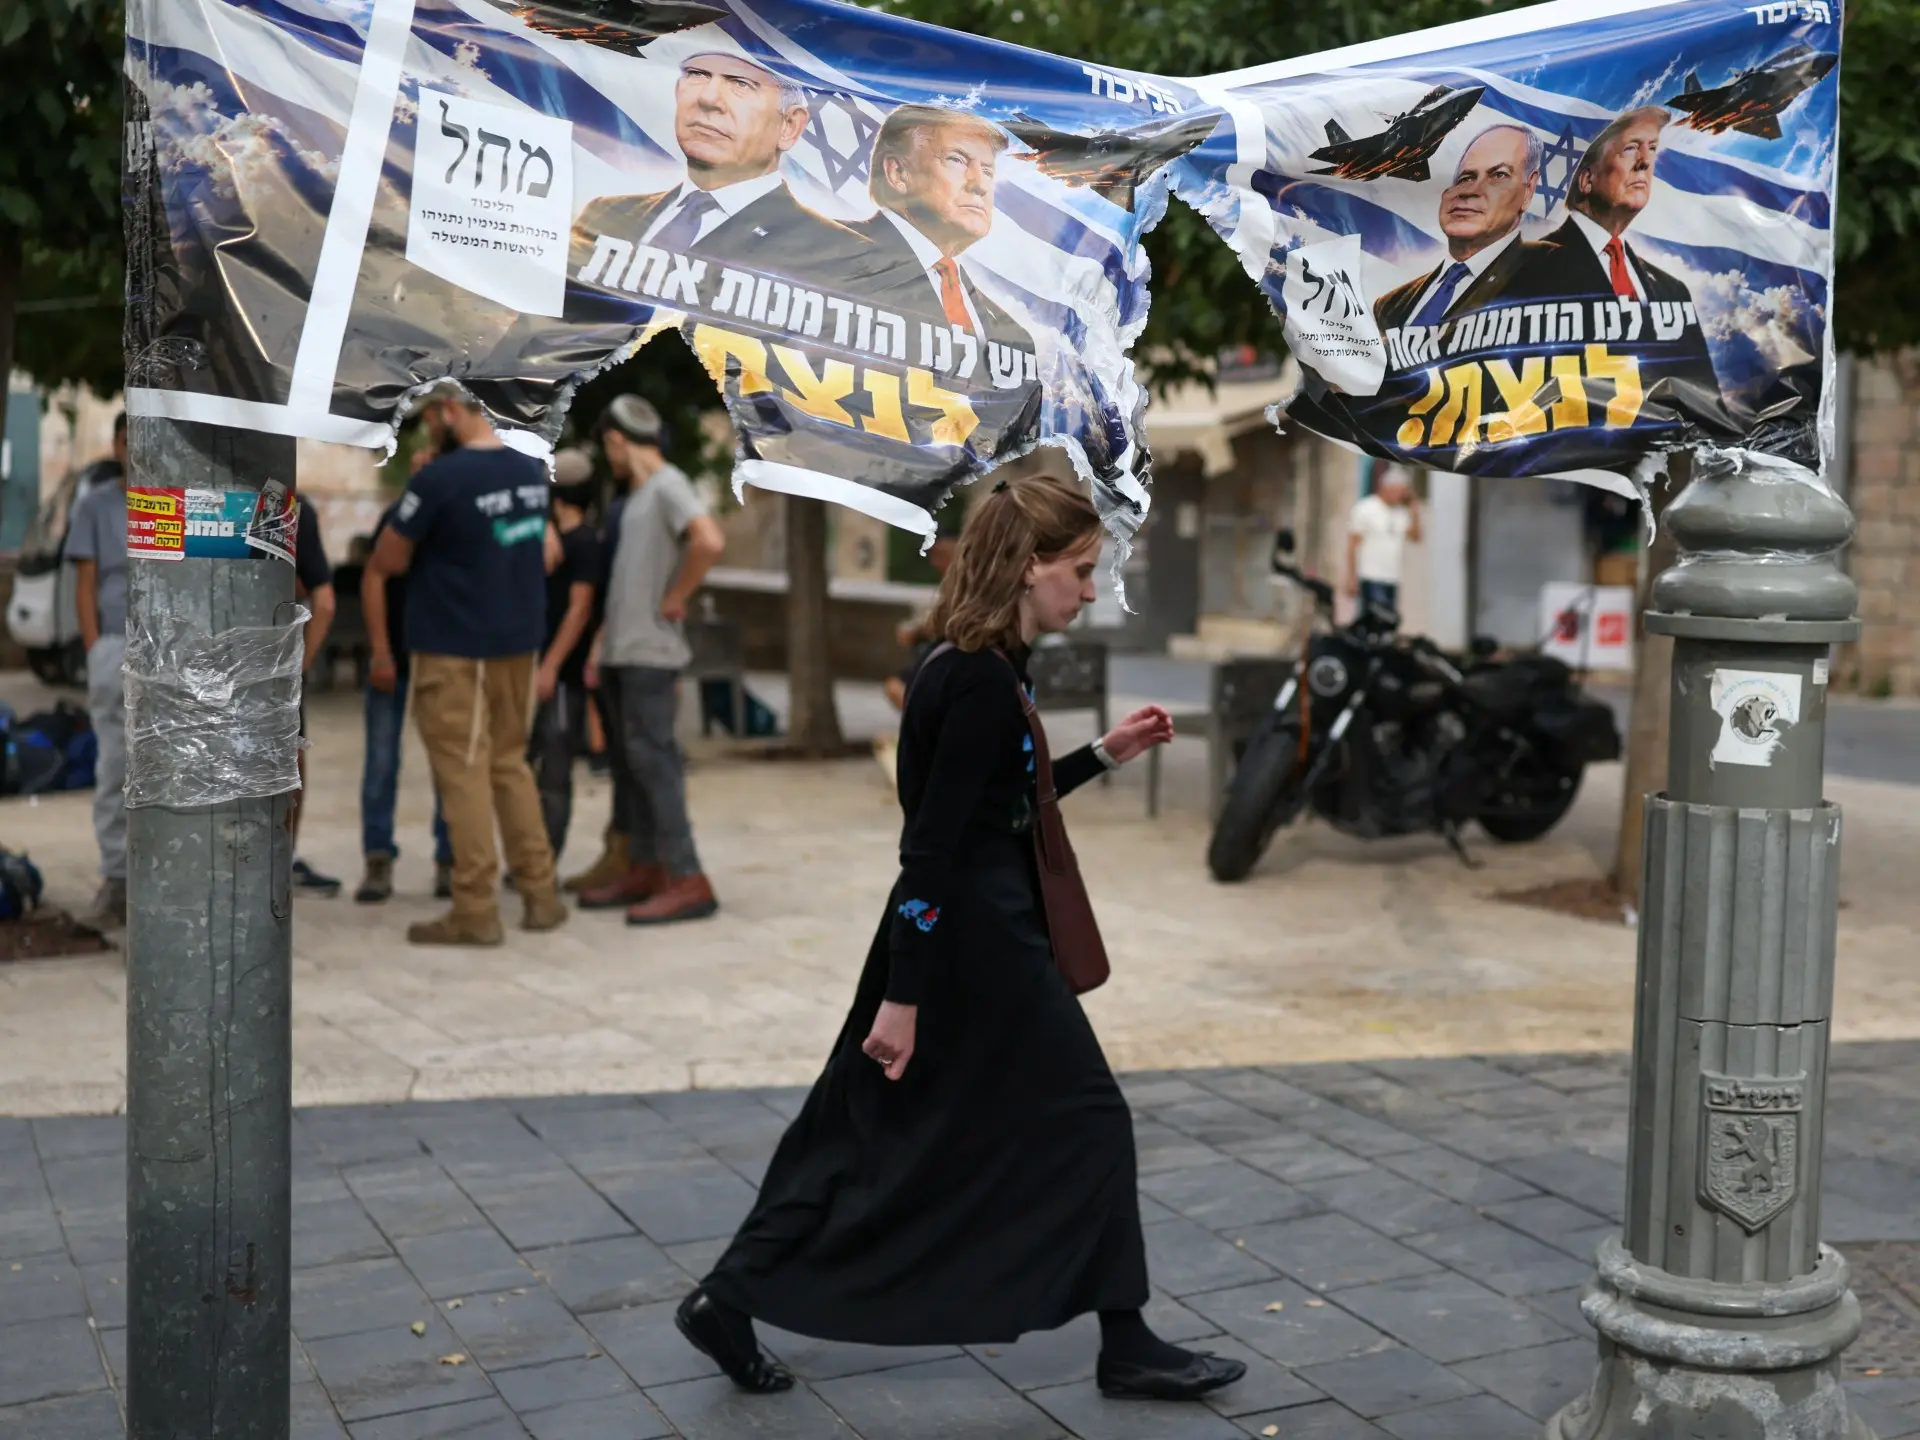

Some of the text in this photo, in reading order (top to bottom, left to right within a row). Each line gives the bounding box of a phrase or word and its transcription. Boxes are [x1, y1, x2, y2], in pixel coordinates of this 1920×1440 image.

[1743, 0, 1831, 25] הליכוד
[1082, 65, 1185, 114] הליכוד
[439, 99, 553, 198] מחל
[470, 197, 514, 213] הליכוד
[421, 209, 558, 241] בהנהגת בנימין נתניהו
[431, 230, 544, 257] לראשות הממשלה
[576, 234, 707, 305] אחת
[1319, 318, 1353, 331] הליכוד
[1593, 294, 1643, 341] לנו
[1649, 300, 1699, 341] יש
[919, 322, 978, 379] לנו
[1336, 348, 1371, 358] לראשות
[1385, 323, 1451, 372] אחת
[640, 304, 980, 447] לנצח
[1397, 343, 1643, 449] לנצח!
[156, 521, 180, 533] זרקת
[156, 536, 180, 548] זרקת
[1707, 1080, 1802, 1110] ירושלים
